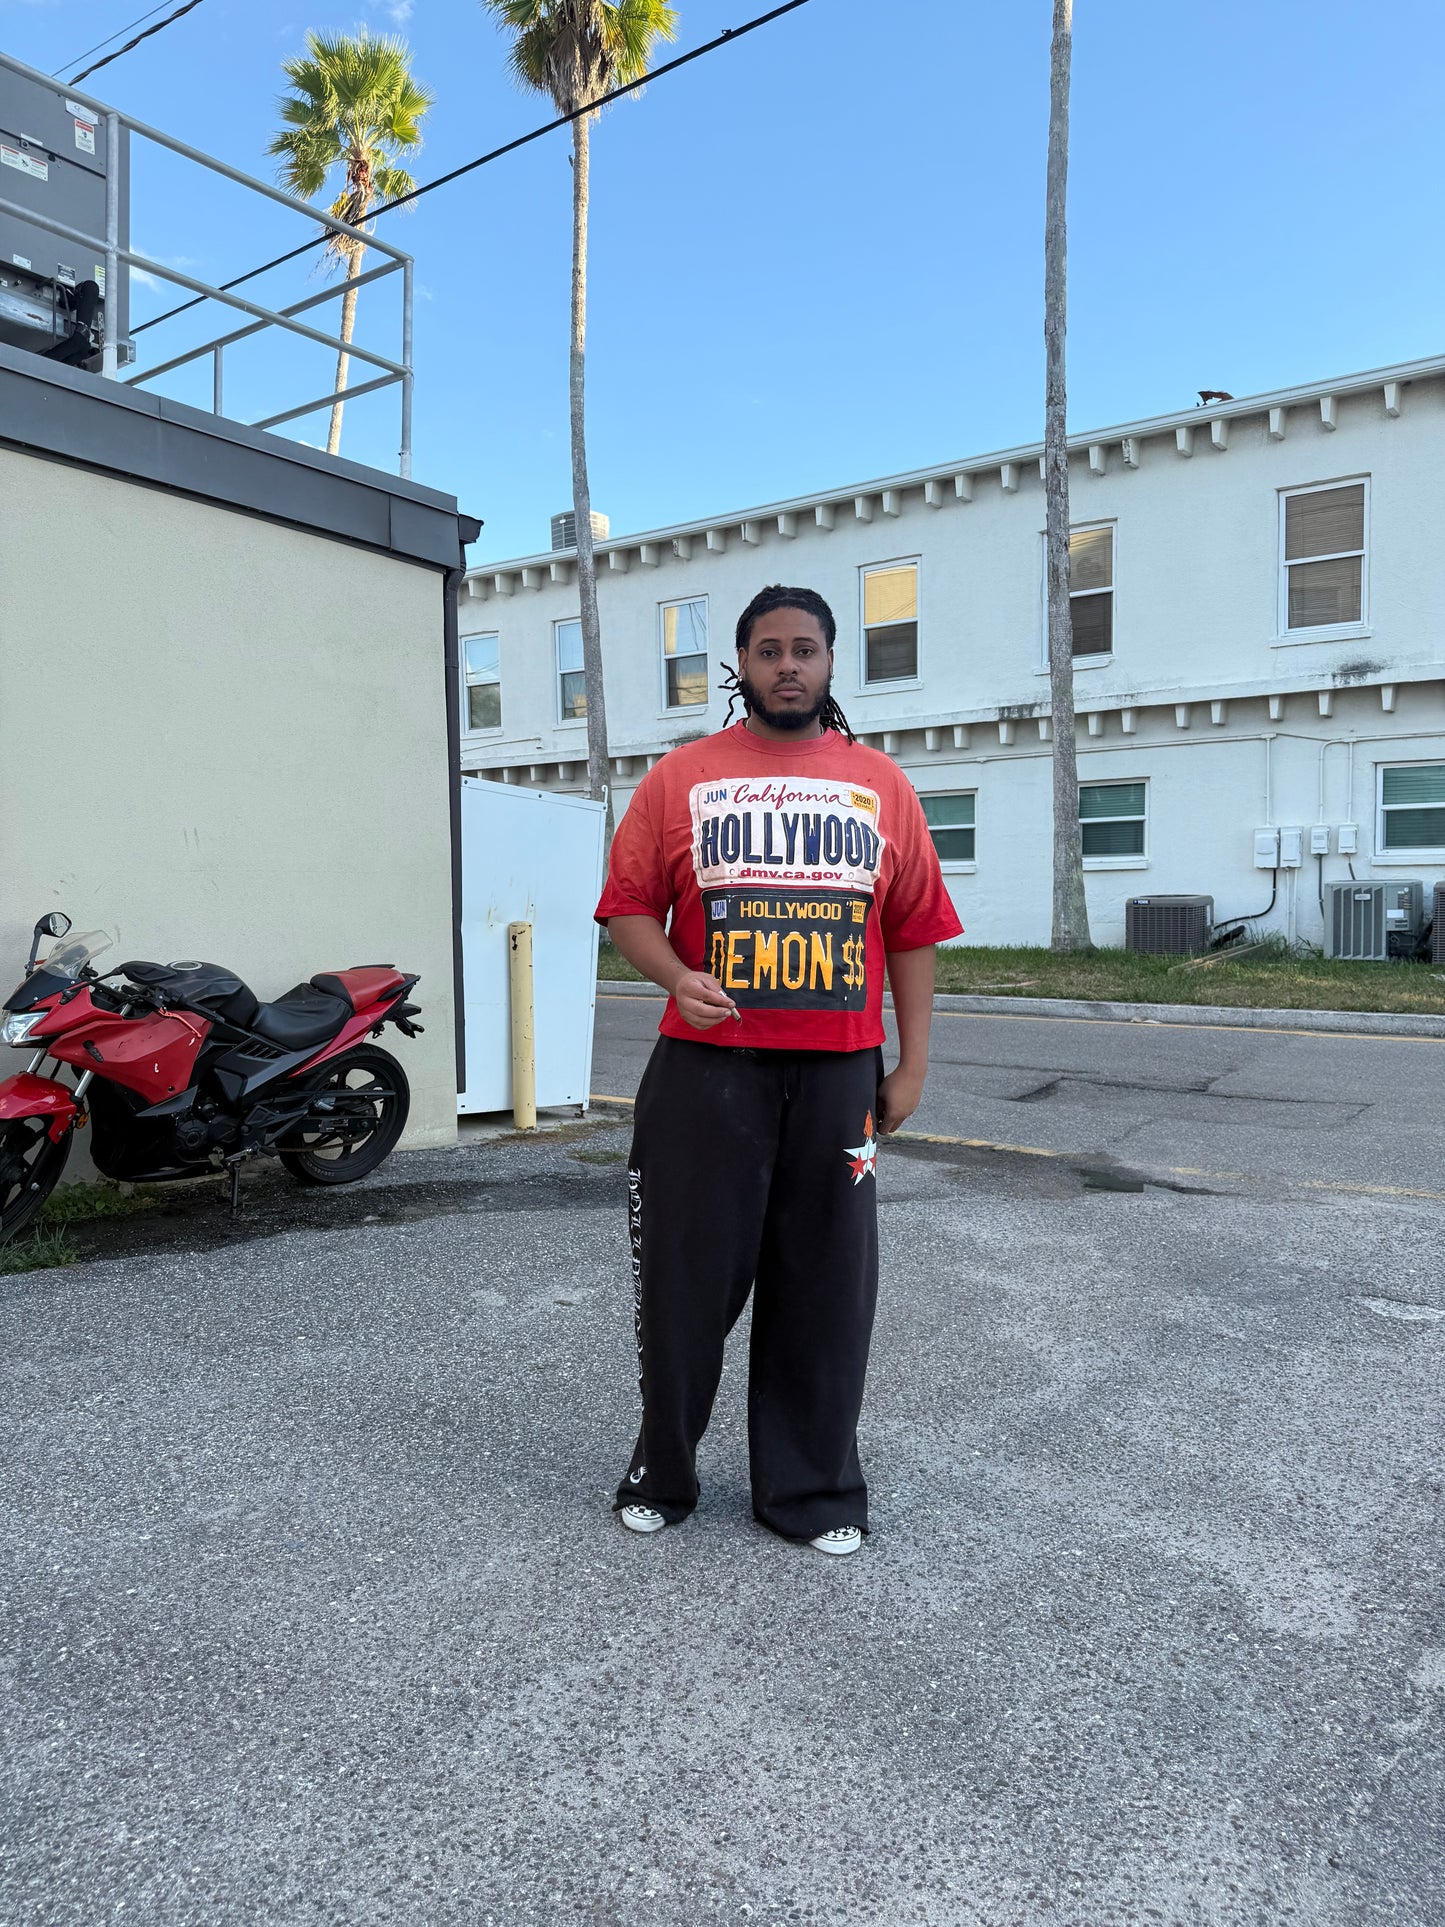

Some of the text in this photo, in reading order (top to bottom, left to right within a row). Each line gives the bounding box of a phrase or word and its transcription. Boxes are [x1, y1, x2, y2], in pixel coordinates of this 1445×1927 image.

[704, 788, 727, 804] JUN
[733, 784, 853, 811] California
[855, 794, 871, 805] 2020
[701, 812, 879, 871] HOLLYWOOD
[740, 867, 843, 880] dmv.ca.gov
[712, 901, 726, 917] JUN
[740, 901, 842, 920] HOLLYWOOD
[711, 930, 865, 990] DEMON $$
